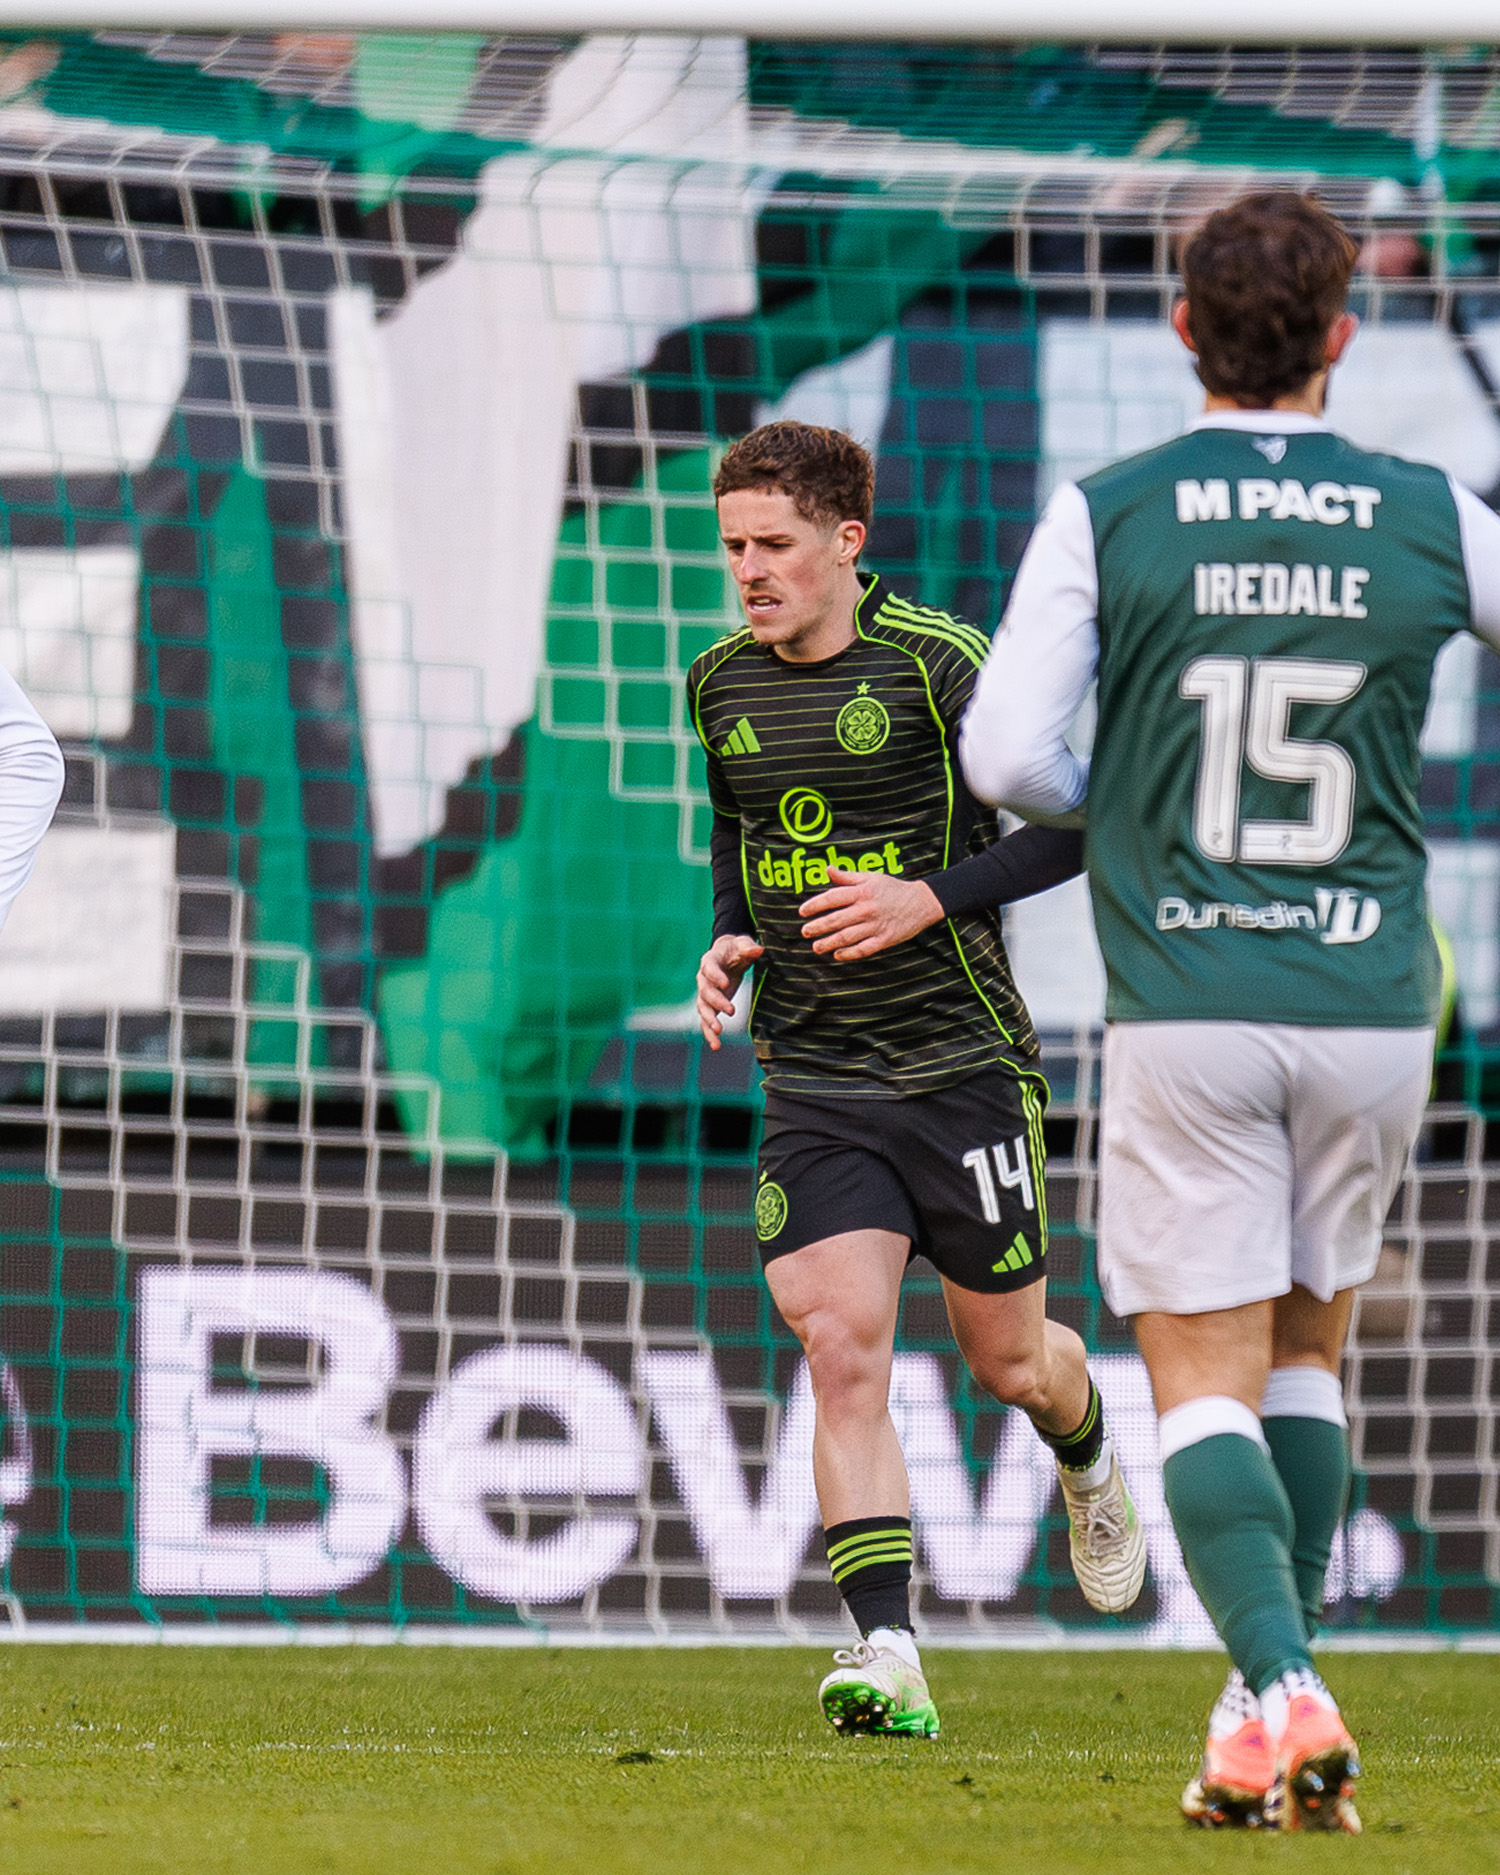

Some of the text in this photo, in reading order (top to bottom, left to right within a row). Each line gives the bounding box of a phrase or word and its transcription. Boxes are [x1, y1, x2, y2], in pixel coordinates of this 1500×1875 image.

[1194, 562, 1370, 619] IREDALE
[1178, 653, 1368, 867] 15
[758, 841, 904, 894] dafabet
[962, 1134, 1035, 1225] 14
